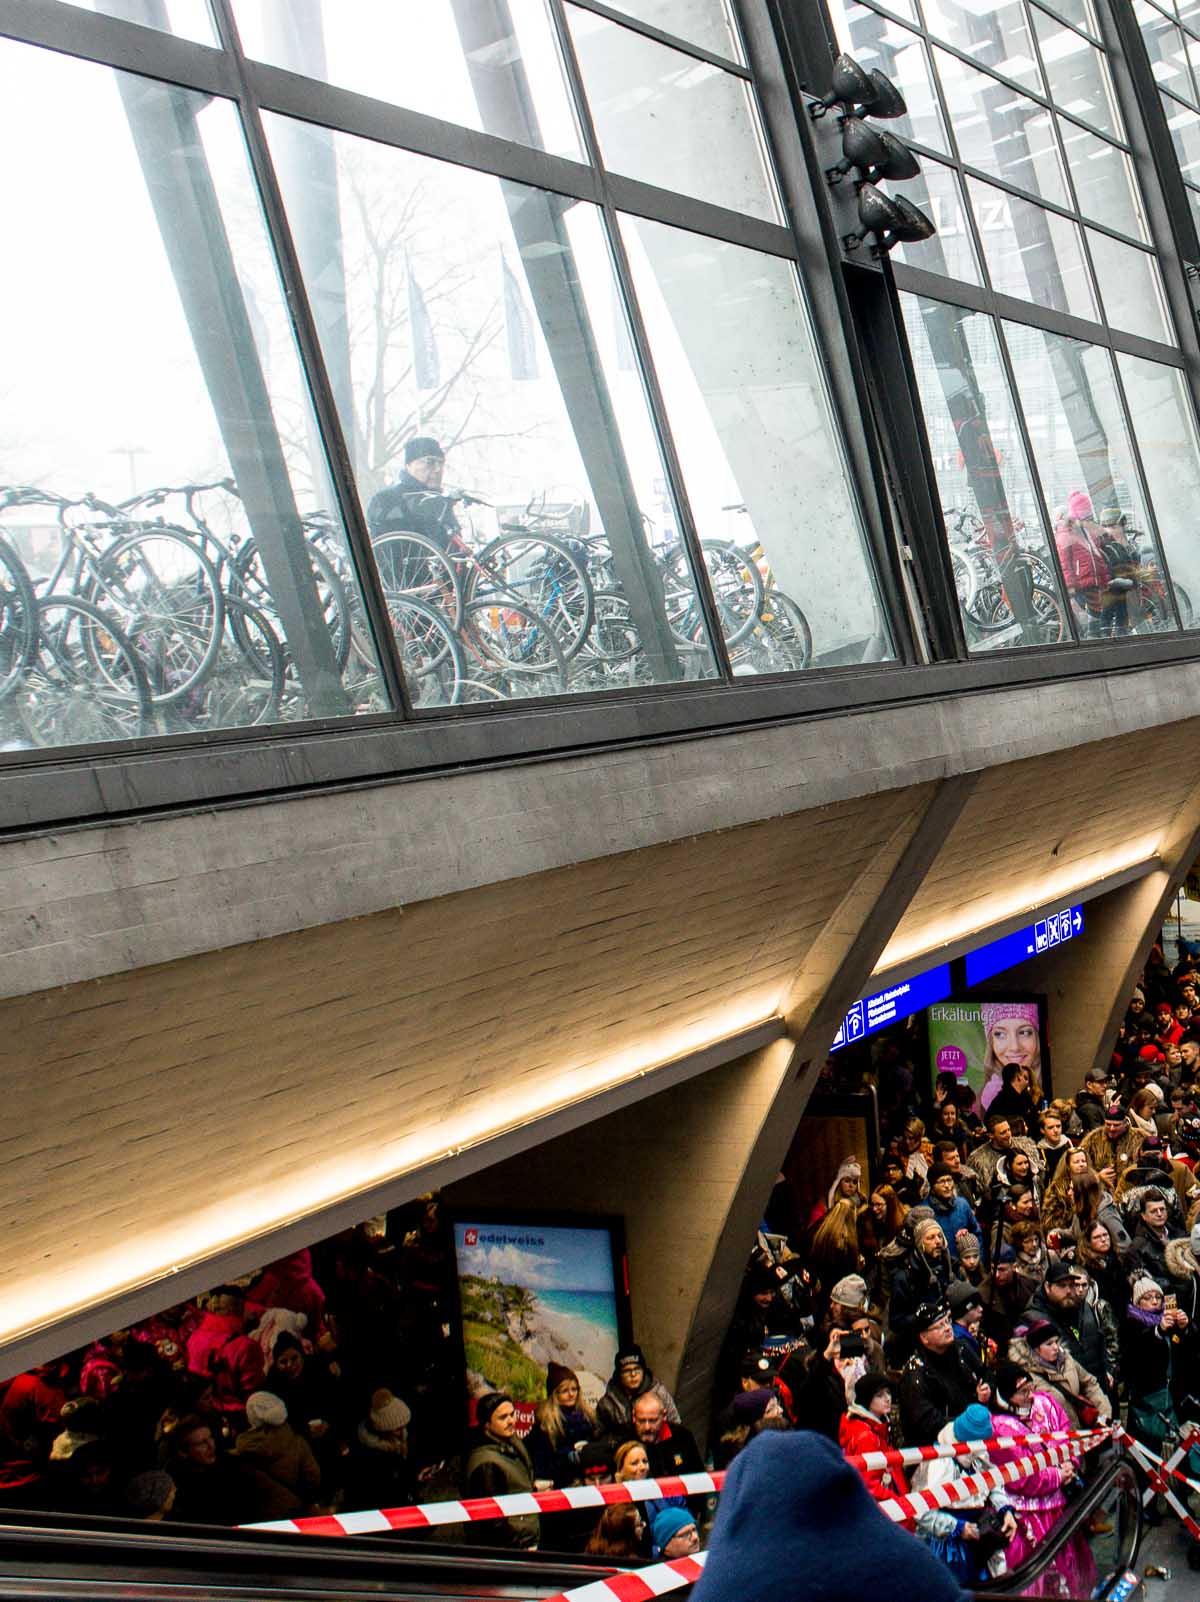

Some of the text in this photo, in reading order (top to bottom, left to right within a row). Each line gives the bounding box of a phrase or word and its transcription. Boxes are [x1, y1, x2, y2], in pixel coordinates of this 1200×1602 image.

[931, 197, 1014, 237] Luz
[1037, 934, 1048, 949] WC
[931, 1007, 994, 1025] Erkältung?
[941, 1050, 961, 1062] JETZT
[479, 1231, 545, 1247] edelweiss
